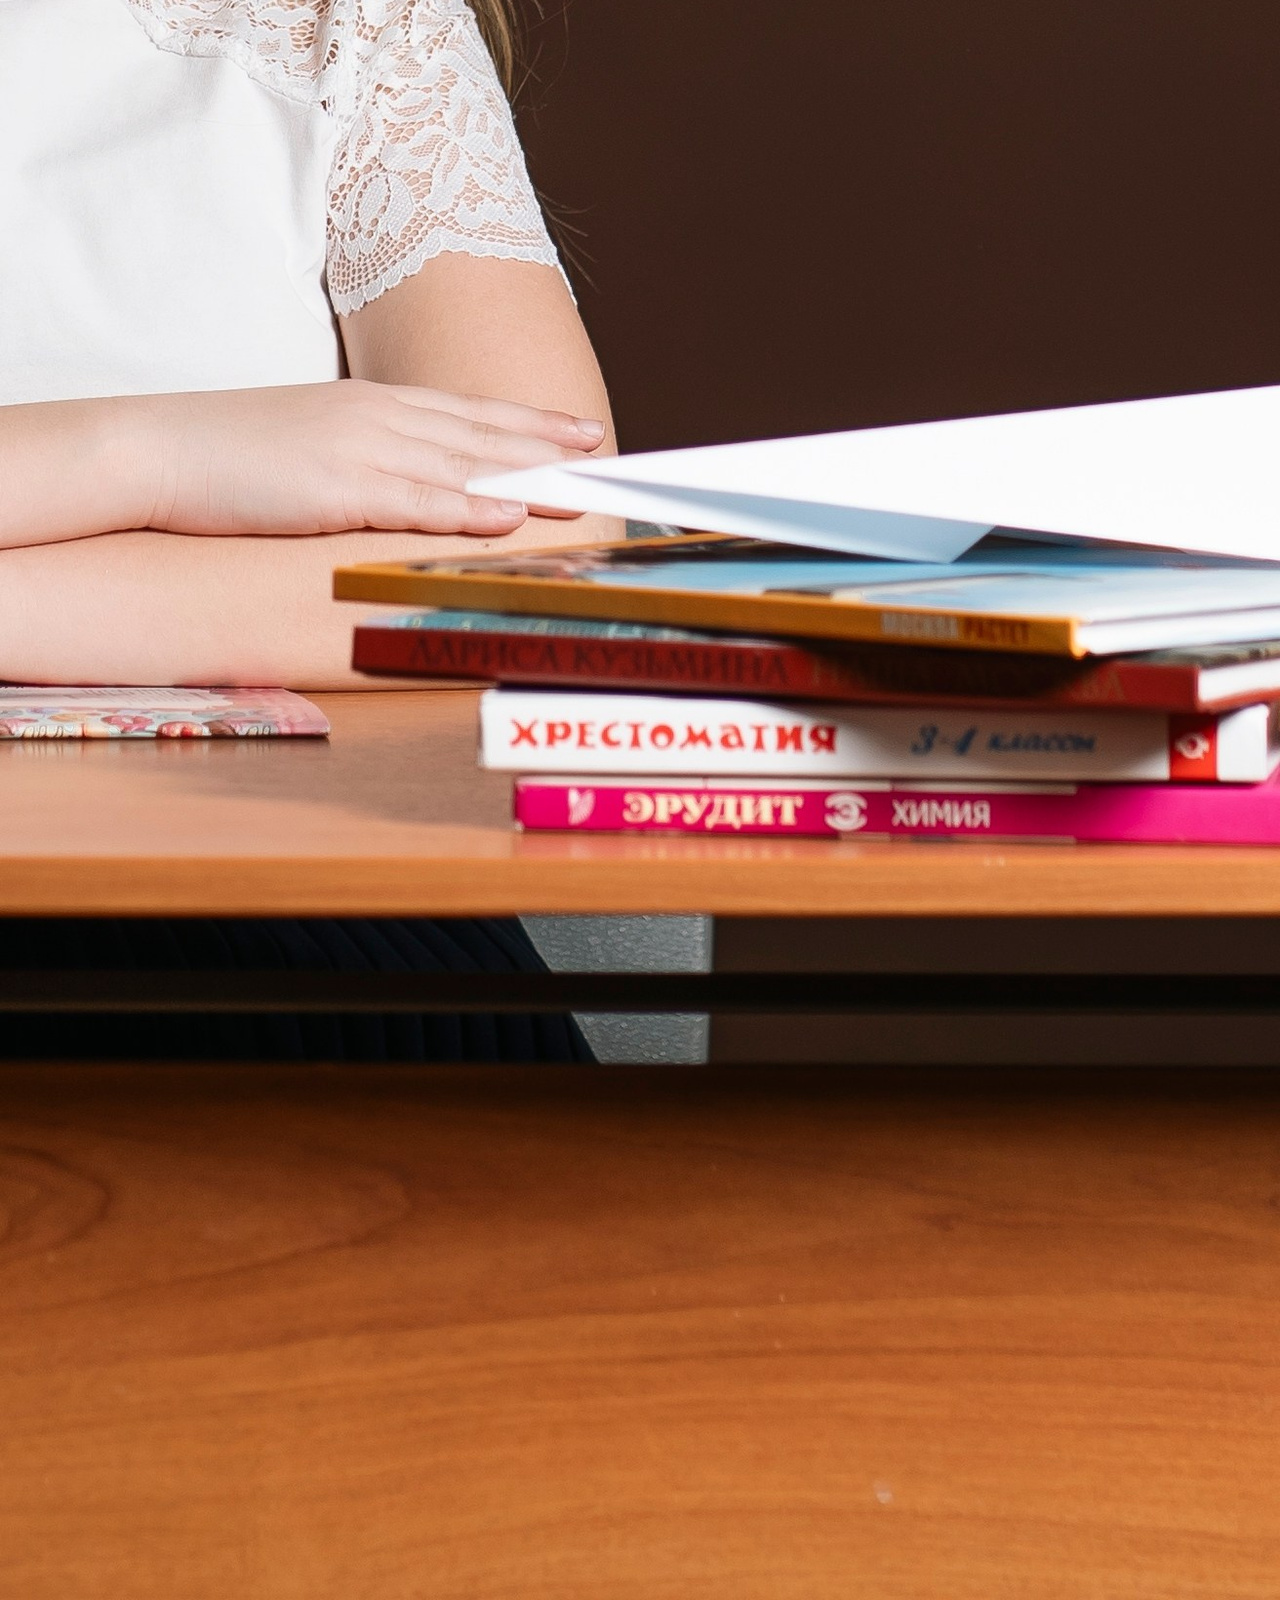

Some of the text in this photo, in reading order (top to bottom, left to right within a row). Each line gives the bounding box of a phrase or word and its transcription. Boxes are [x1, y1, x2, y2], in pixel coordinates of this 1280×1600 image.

[409, 636, 560, 672] ЛАРИСА
[572, 644, 788, 686] КУЗЬМИНА
[510, 717, 837, 753] ХРЕСТОМАТИЯ
[622, 791, 804, 830] ЭРУДИТ
[891, 798, 992, 829] ХИМИЯ
